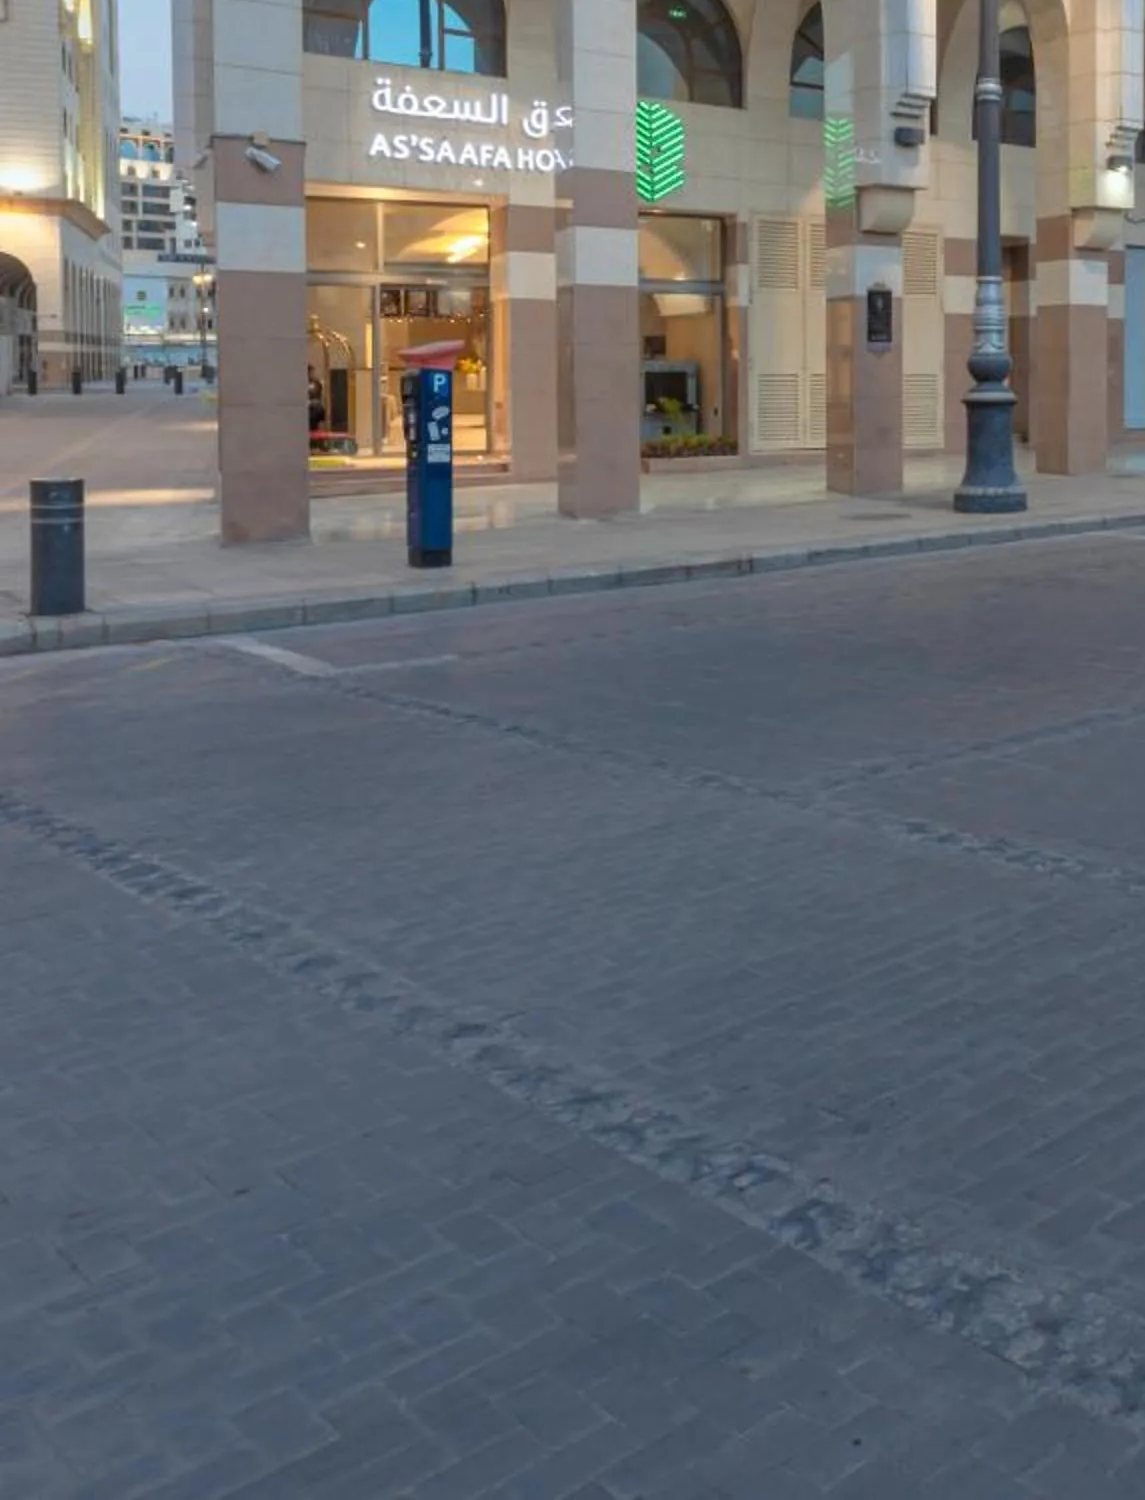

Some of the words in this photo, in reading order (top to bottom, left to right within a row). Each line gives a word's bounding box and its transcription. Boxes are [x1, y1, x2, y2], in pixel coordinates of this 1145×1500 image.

[371, 77, 510, 126] السعفة
[369, 132, 512, 170] AS'SAAFA
[433, 373, 446, 393] P
